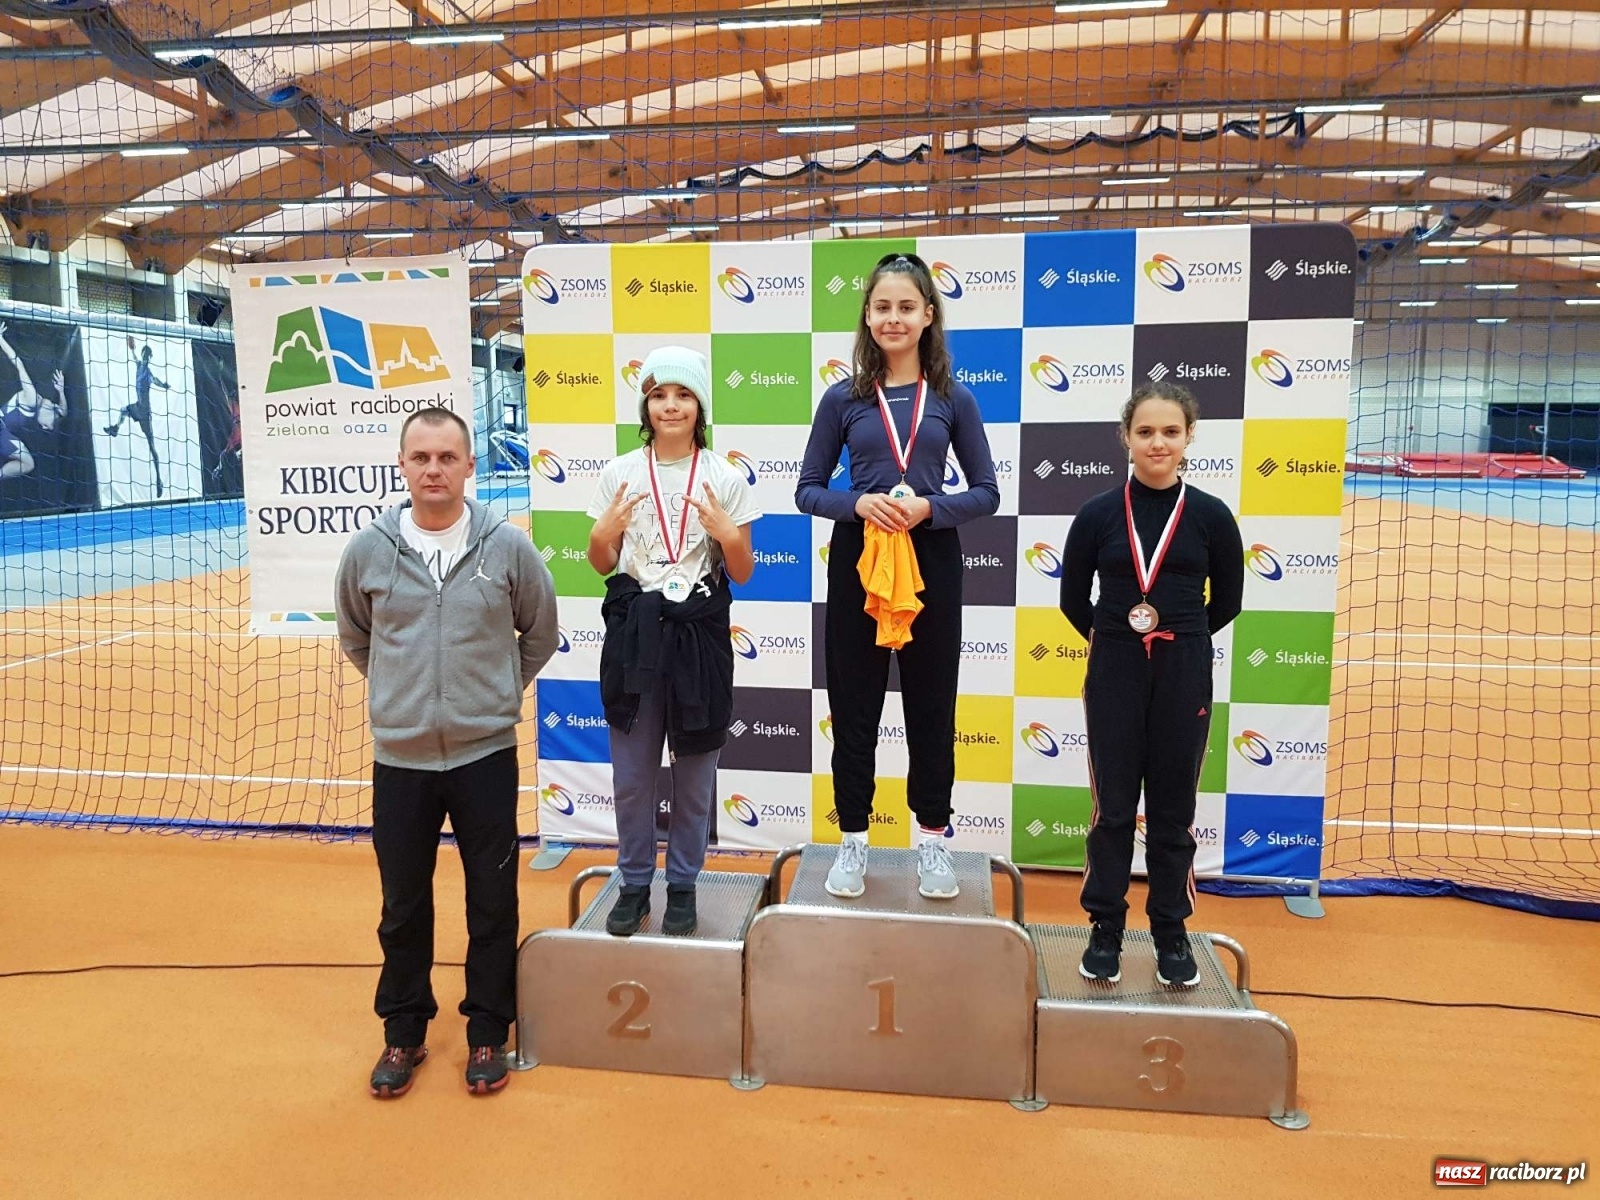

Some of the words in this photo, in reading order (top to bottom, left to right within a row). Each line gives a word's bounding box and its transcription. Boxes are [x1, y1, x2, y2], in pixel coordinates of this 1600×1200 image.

[966, 270, 1016, 284] ZSOMS
[1066, 268, 1120, 286] Śląskie.
[1188, 262, 1242, 276] ZSOMS
[1295, 260, 1352, 279] Śląskie.
[561, 278, 606, 291] ZSOMS
[650, 278, 698, 296] Śląskie.
[757, 276, 804, 290] ZSOMS
[1072, 364, 1124, 378] ZSOMS
[1176, 362, 1230, 380] Śląskie.
[1296, 358, 1350, 372] ZSOMS
[556, 370, 602, 388] Śląskie.
[751, 370, 798, 388] Śląskie.
[956, 368, 1008, 386] Śląskie.
[266, 398, 337, 423] powiat
[351, 393, 454, 414] raciborski
[266, 424, 330, 436] zielona
[344, 423, 388, 434] oaza
[1061, 460, 1114, 478] Śląskie.
[1286, 458, 1341, 476] Śląskie.
[280, 465, 411, 500] KIBICUJE
[962, 554, 1003, 570] ląskie.
[1286, 554, 1339, 568] ZSOMS
[572, 630, 606, 642] ZSOM
[760, 636, 805, 649] ZSOMS
[1274, 648, 1329, 666] Śląskie.
[753, 720, 800, 738] Śląskie.
[1062, 733, 1087, 746] ZSO
[1276, 741, 1328, 754] ZSOMS
[578, 793, 614, 806] ZSOM
[760, 804, 806, 818] ZSOMS
[957, 814, 1005, 828] ZSOMS
[1267, 830, 1320, 848] Śląskie.
[607, 980, 651, 1039] 2
[867, 977, 903, 1036] 1
[1136, 1036, 1186, 1099] 3
